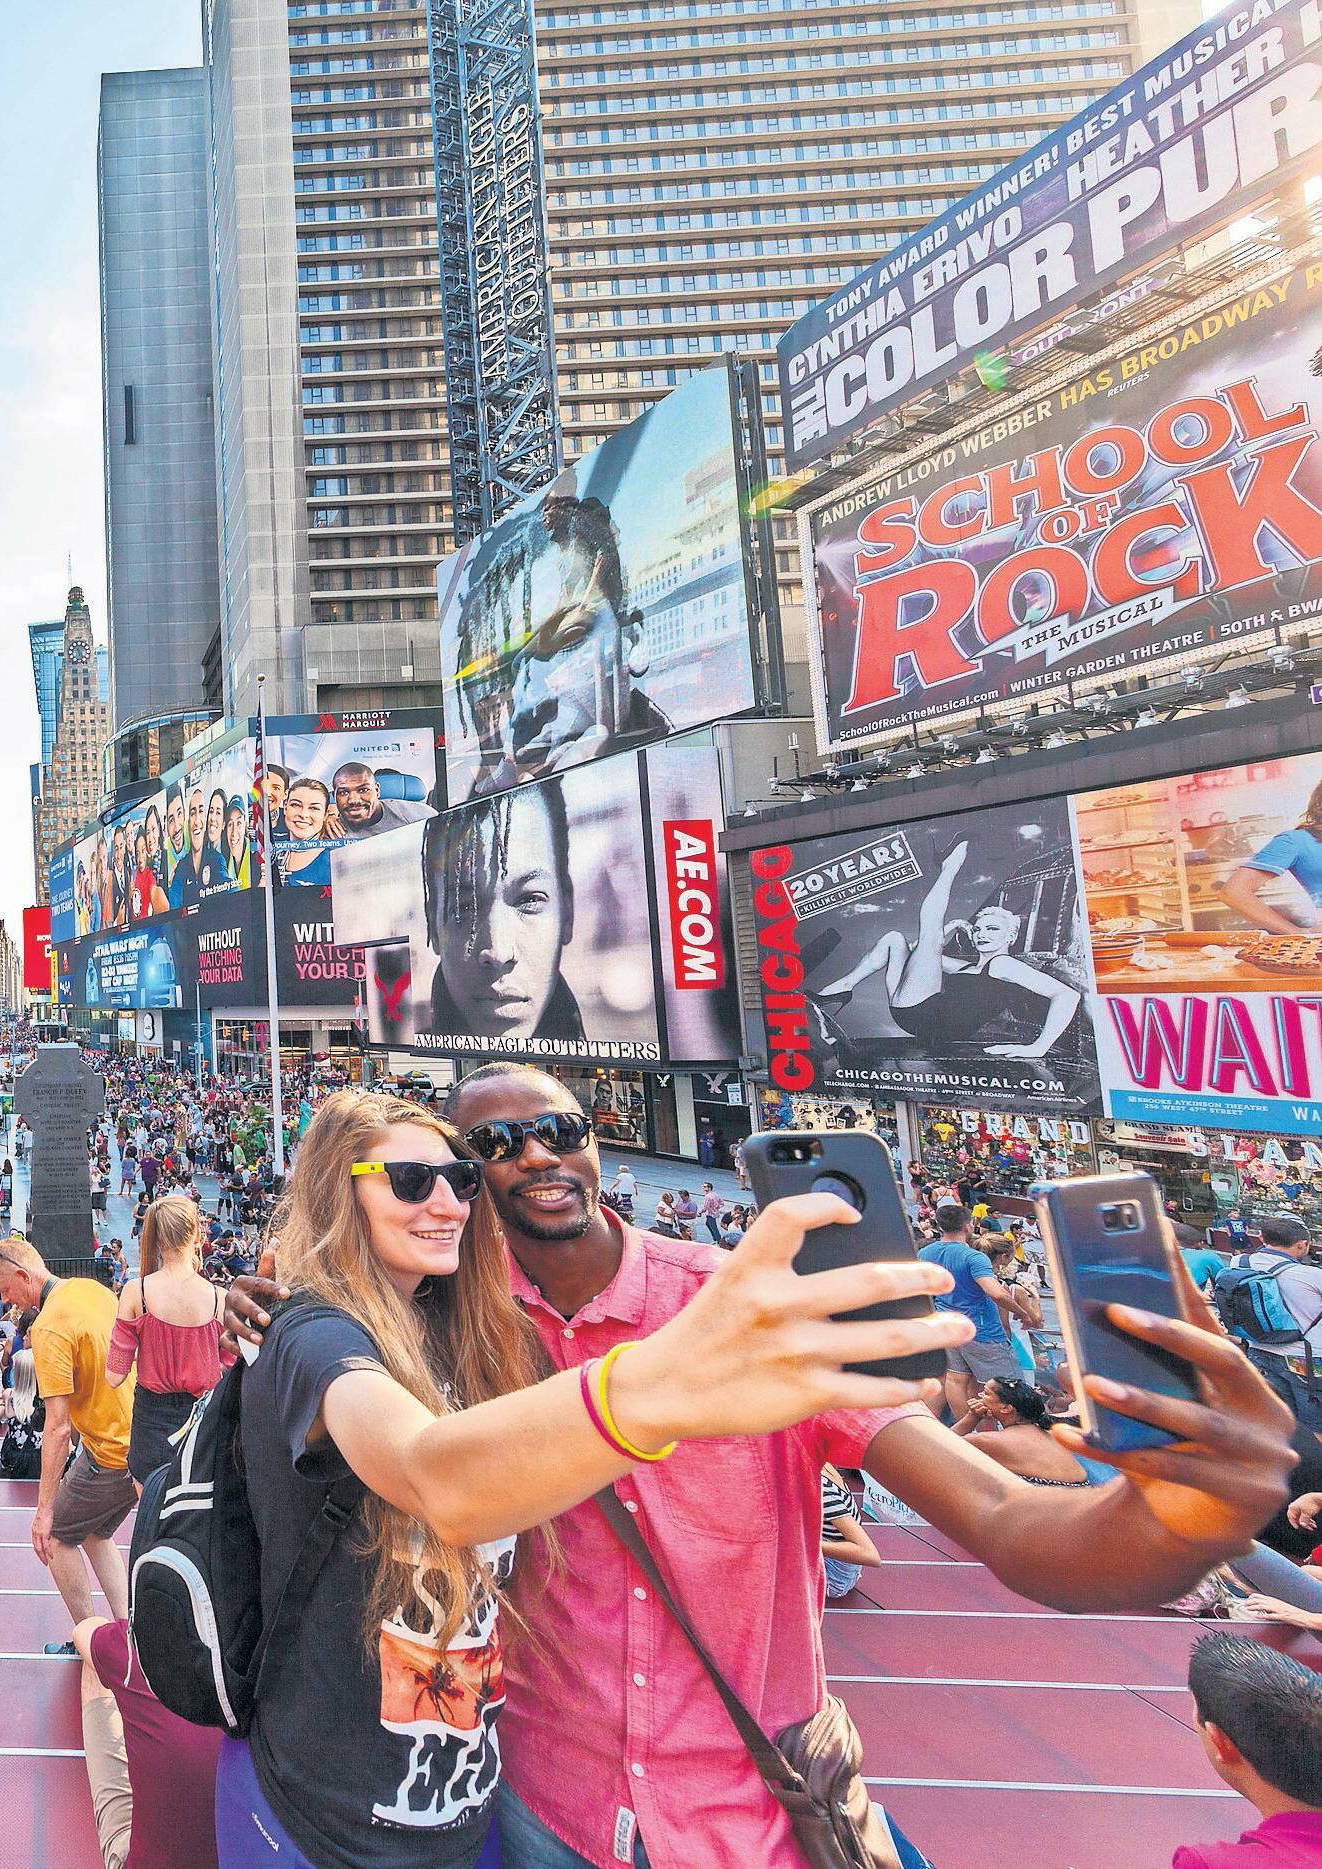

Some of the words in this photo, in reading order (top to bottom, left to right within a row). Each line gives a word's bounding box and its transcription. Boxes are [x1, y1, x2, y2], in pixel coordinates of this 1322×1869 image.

[788, 287, 907, 386] CYNTHIA
[913, 206, 1023, 303] ERIVO
[1067, 27, 1286, 202] HEATHER
[827, 277, 874, 324] TONY
[879, 226, 949, 289] AWARD
[956, 145, 1059, 232] WINNER!
[1067, 90, 1135, 155] BEST
[825, 221, 1078, 428] COLOR
[896, 446, 957, 491] LLOYD
[961, 399, 1052, 456] WEBBER
[1060, 369, 1113, 409] HAS
[1120, 285, 1291, 376] BROADWAY
[1107, 371, 1151, 397] REUTERS
[790, 375, 827, 452] THE
[854, 376, 1310, 576] SCHOOL
[1037, 491, 1122, 544] OF
[841, 431, 1322, 718] ROCK
[1021, 625, 1062, 650] THE
[1057, 596, 1164, 652] MUSICAL
[839, 688, 999, 741] SchoolOfRockTheMusical.com
[1010, 670, 1061, 693] WINTER
[1065, 650, 1126, 680] GARDEN
[1130, 631, 1203, 659] THEATRE
[1220, 616, 1265, 637] 50TH
[342, 711, 391, 720] MARRIOTT
[342, 719, 386, 728] MARQUIS
[353, 744, 390, 753] UNITED
[304, 840, 317, 848] Two
[319, 839, 341, 848] Teams.
[789, 874, 820, 901] 20
[821, 838, 905, 884] YEARS
[802, 893, 838, 914] KILLING
[838, 889, 847, 900] IT
[848, 866, 909, 897] WORLDWIDE
[673, 829, 717, 981] AE.COM
[198, 928, 241, 951] WITHOUT
[199, 947, 242, 968] WATCHING
[296, 963, 346, 980] YOUR
[749, 845, 815, 1091] CHICAGO
[200, 967, 225, 983] YOUR
[227, 964, 243, 982] DATA
[414, 1033, 483, 1051] AMERICAN
[488, 1036, 536, 1054] EAGLE
[538, 1039, 659, 1061] OUTFITTERS
[835, 1068, 1066, 1093] CHICAGOTHEMUSICAL.COM
[982, 1092, 1016, 1100] BROADWAY
[1175, 1100, 1222, 1109] ATKINSON
[1225, 1103, 1269, 1112] THEATRE
[959, 1110, 1091, 1144] GRAND
[1125, 1122, 1163, 1130] GRAND
[1164, 1125, 1194, 1133] SLAM
[1134, 1133, 1166, 1142] Souvenir
[1168, 1136, 1186, 1144] Sale
